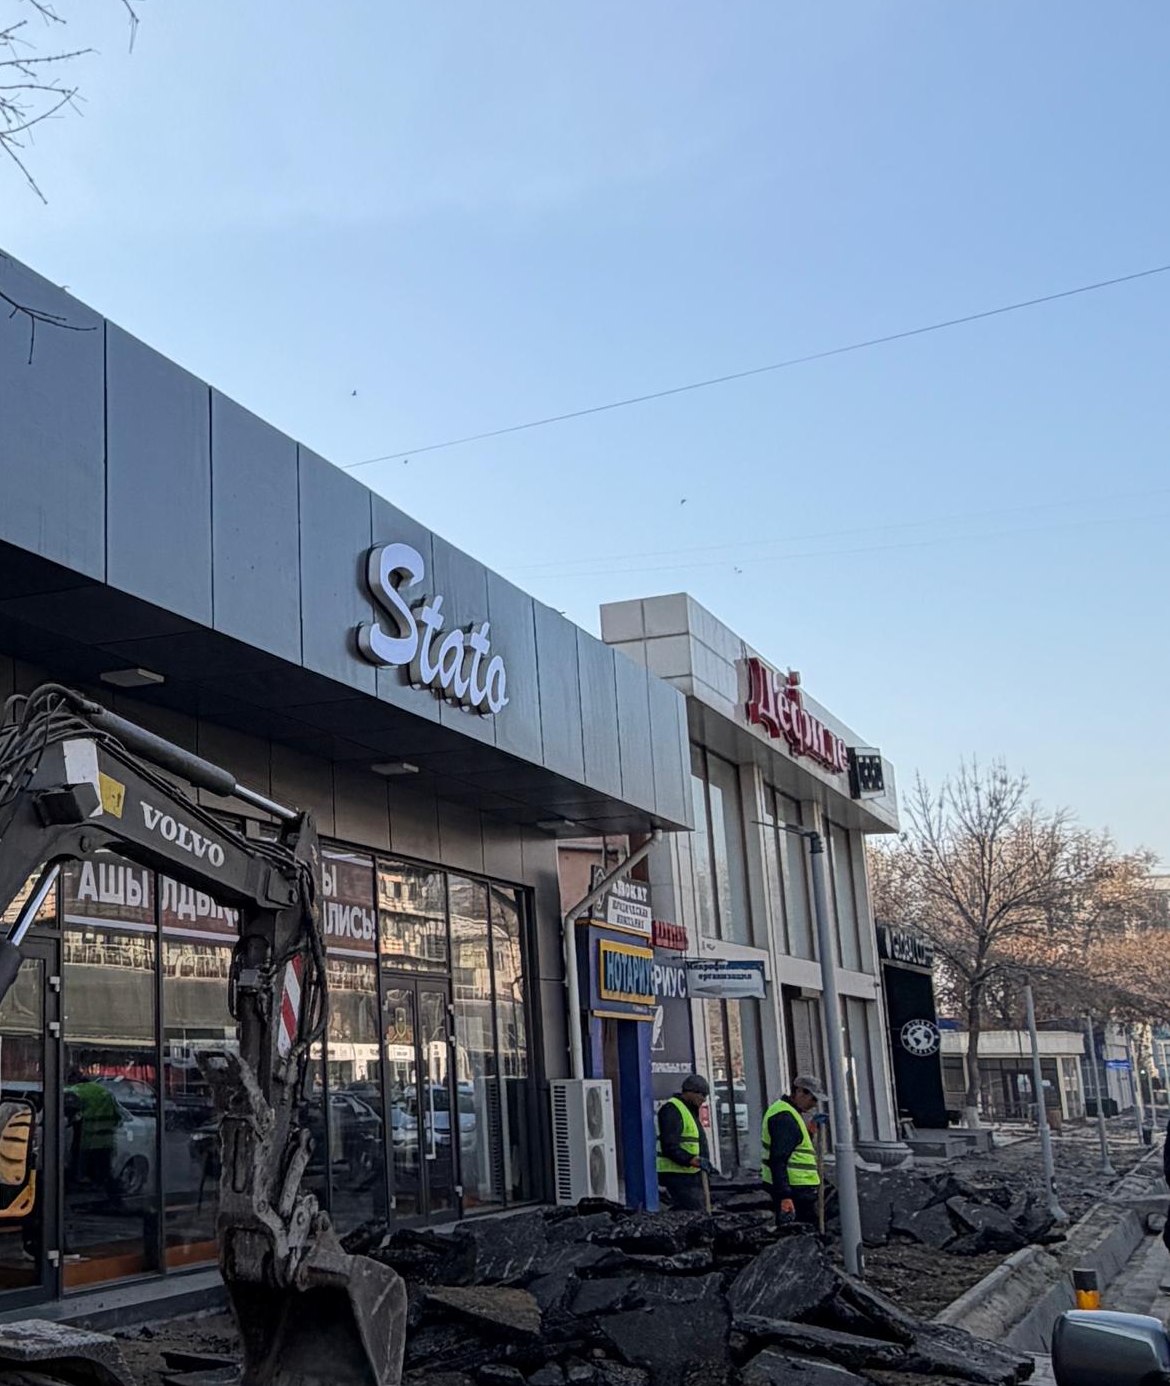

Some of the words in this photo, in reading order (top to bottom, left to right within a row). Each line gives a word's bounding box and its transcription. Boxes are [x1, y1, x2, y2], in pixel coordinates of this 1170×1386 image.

[369, 542, 510, 714] Stato
[140, 800, 225, 868] VOLVO
[323, 900, 376, 942] ЛИСЬ!
[652, 964, 687, 999] РИУС
